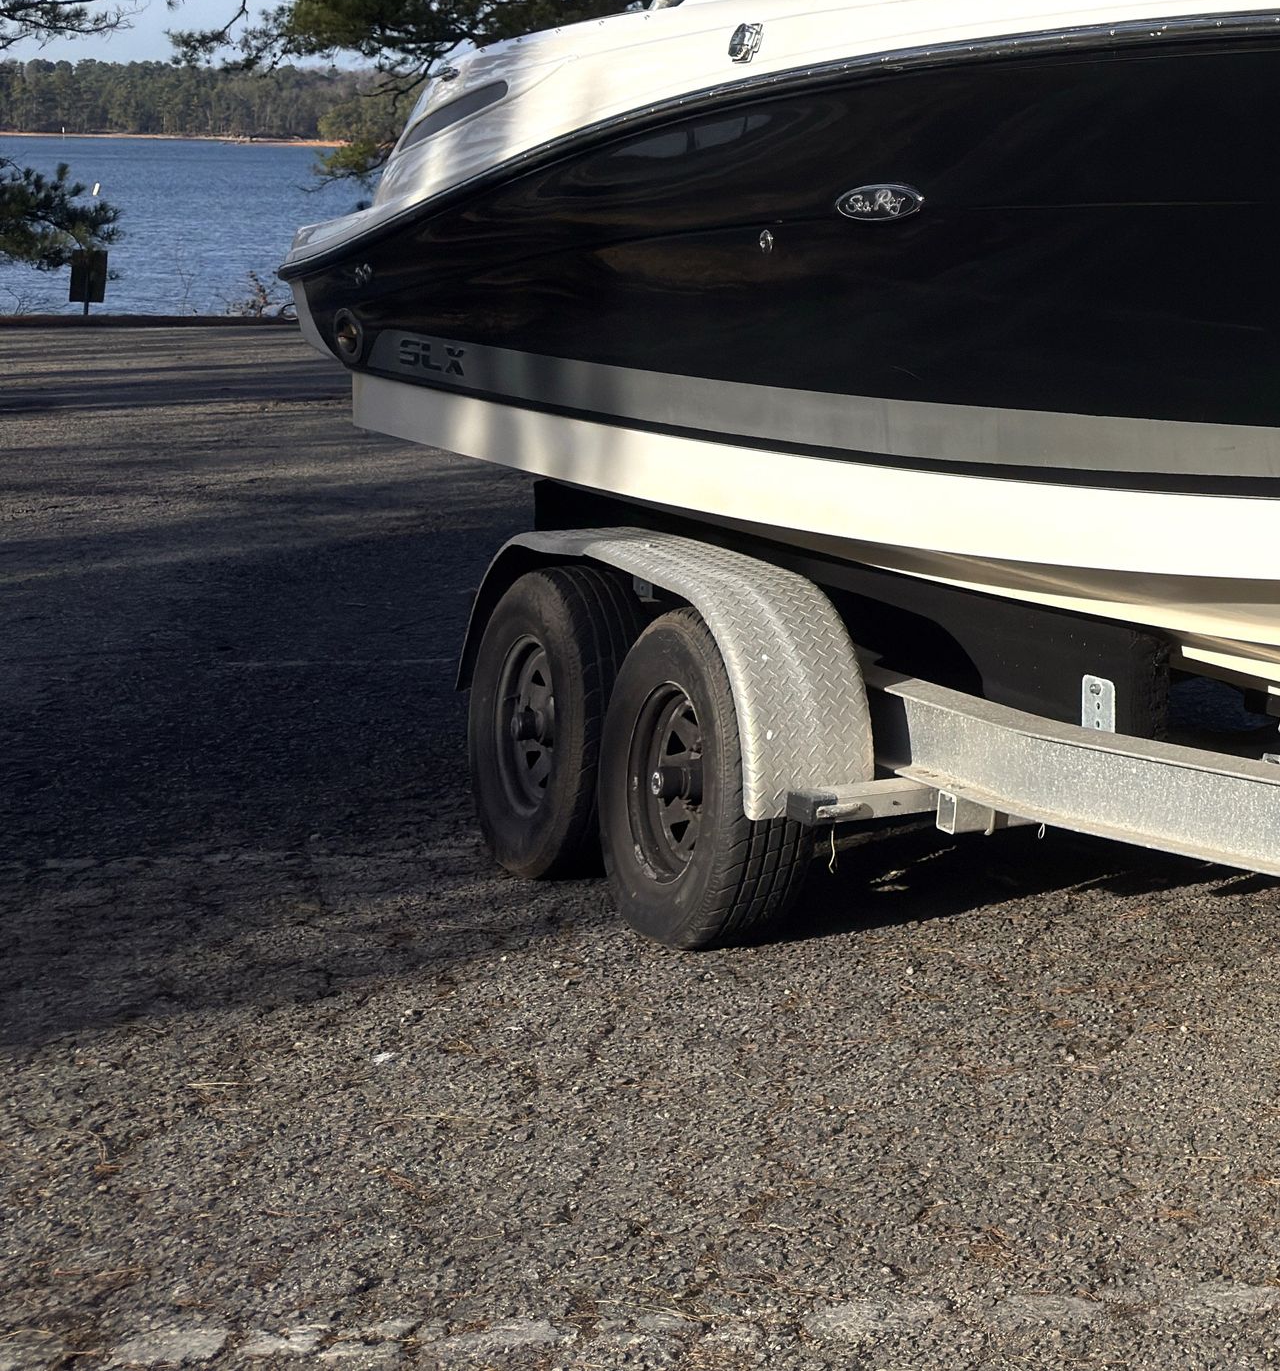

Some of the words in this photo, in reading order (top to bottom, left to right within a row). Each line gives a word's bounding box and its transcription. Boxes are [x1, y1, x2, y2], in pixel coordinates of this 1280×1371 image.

[846, 194, 872, 213] Sea
[874, 189, 906, 215] Ray
[400, 339, 465, 376] SLX
